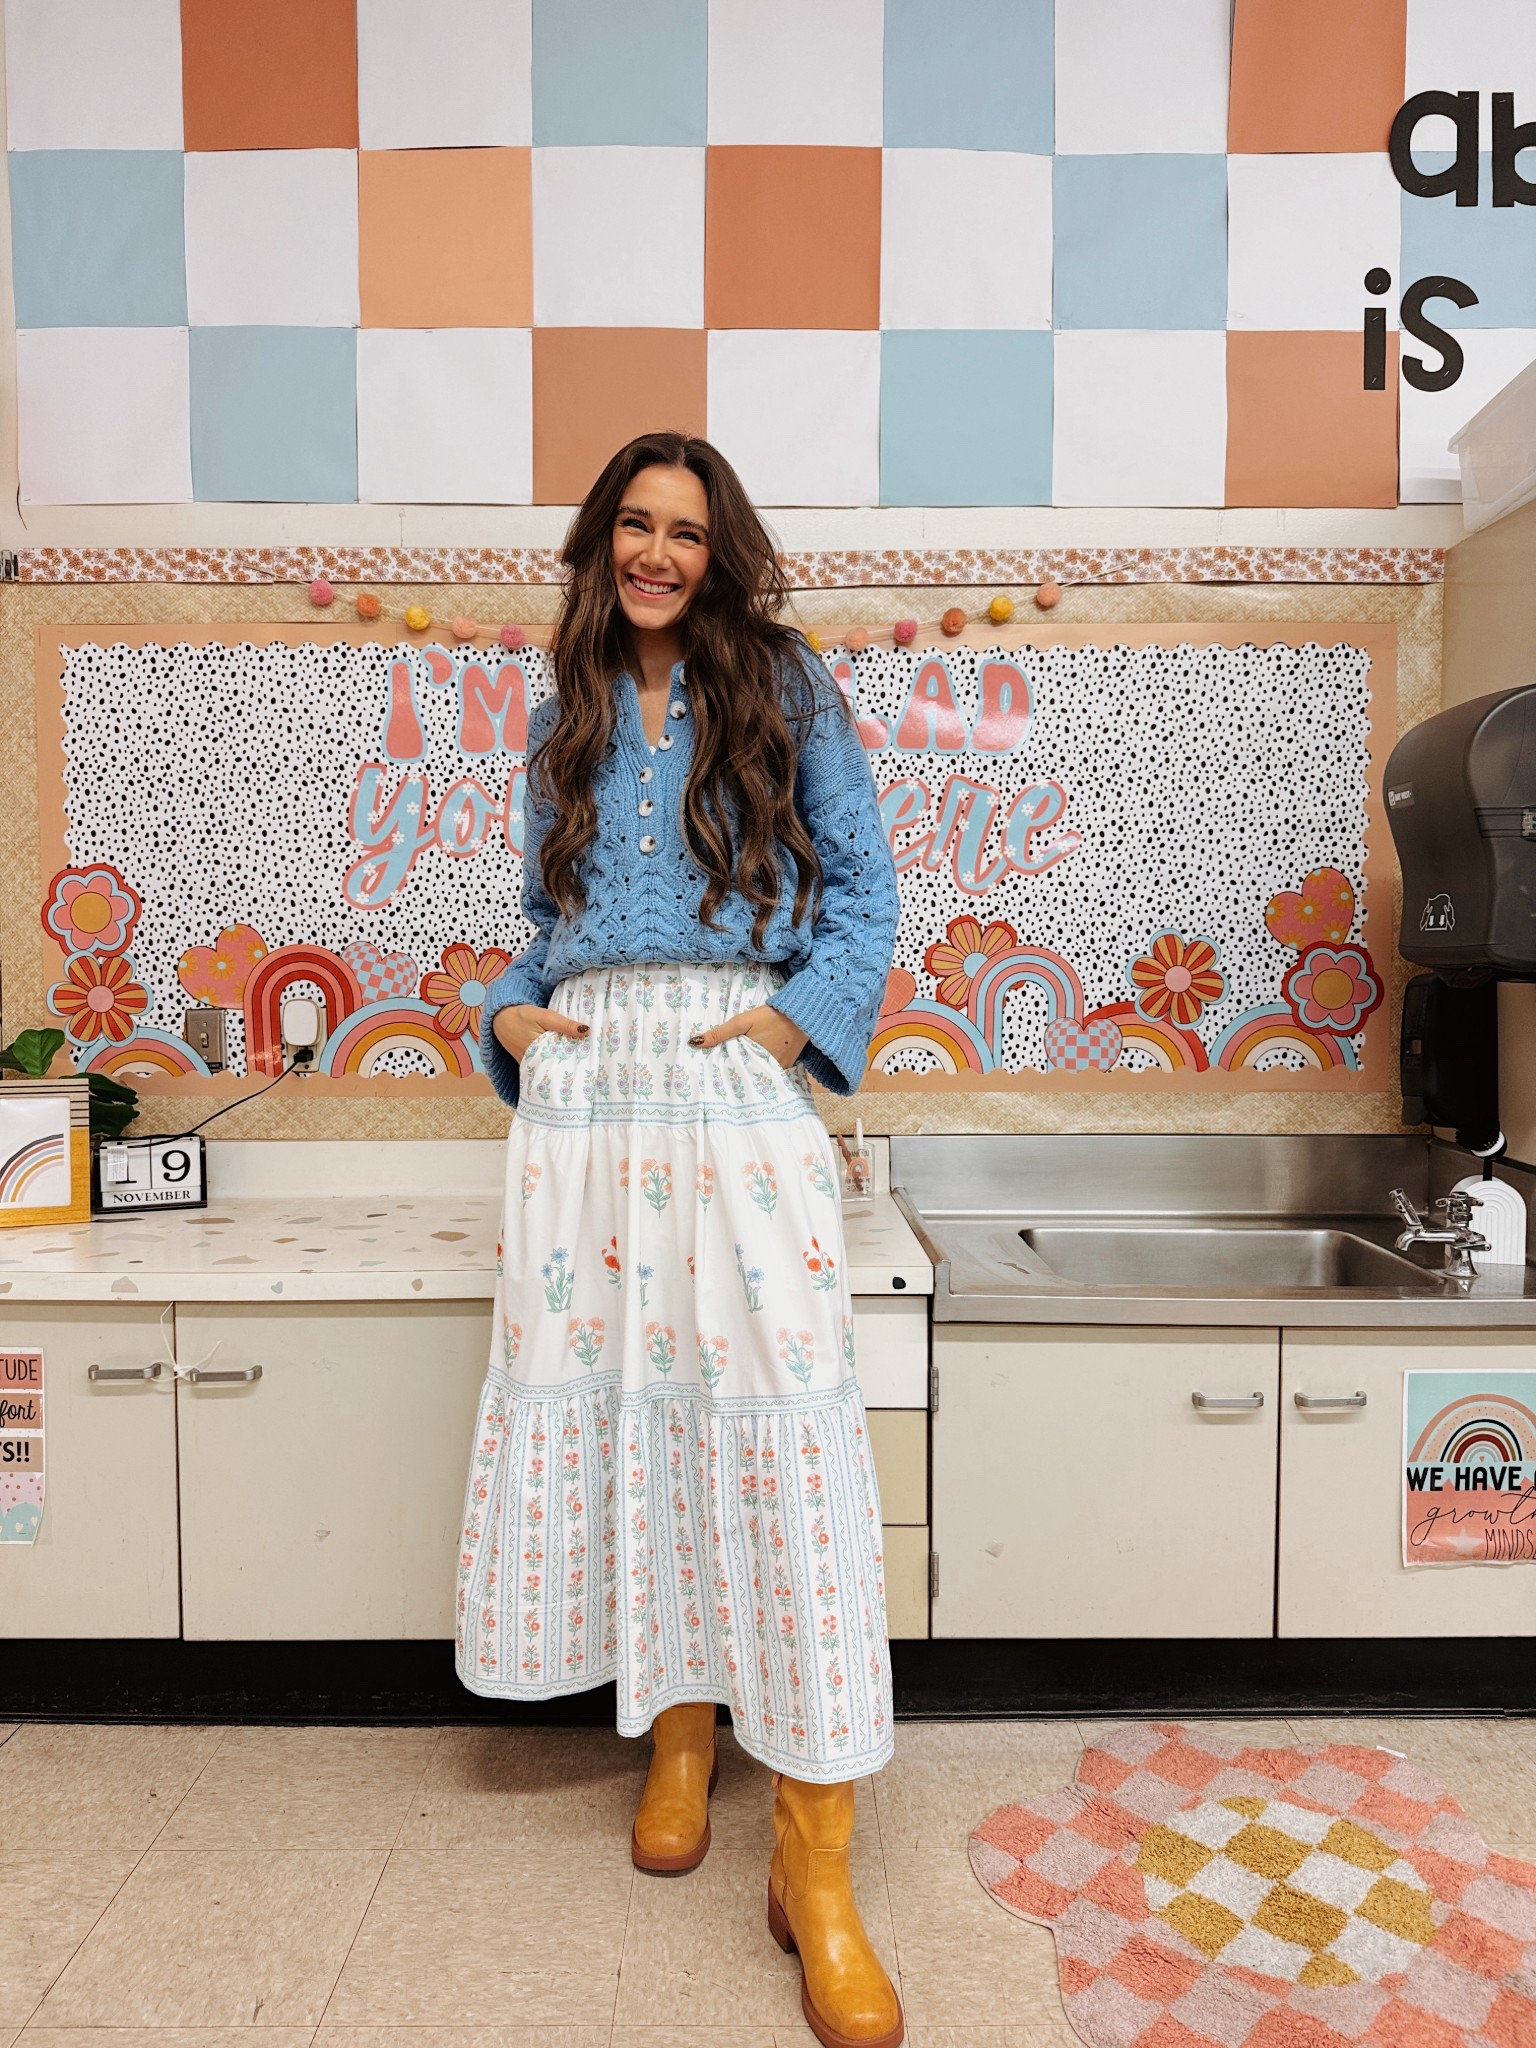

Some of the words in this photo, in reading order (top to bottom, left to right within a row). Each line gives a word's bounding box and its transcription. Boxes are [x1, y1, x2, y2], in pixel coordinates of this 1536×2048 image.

[1363, 267, 1479, 392] is
[381, 646, 530, 764] I'M
[829, 657, 1034, 757] LAD
[876, 774, 1083, 896] ere
[113, 1190, 191, 1204] NOVEMBER
[0, 1441, 30, 1463] S!!
[1407, 1467, 1444, 1492] WE
[1455, 1466, 1522, 1491] HAVE
[1410, 1486, 1536, 1546] growt
[1485, 1528, 1536, 1560] MINDS
